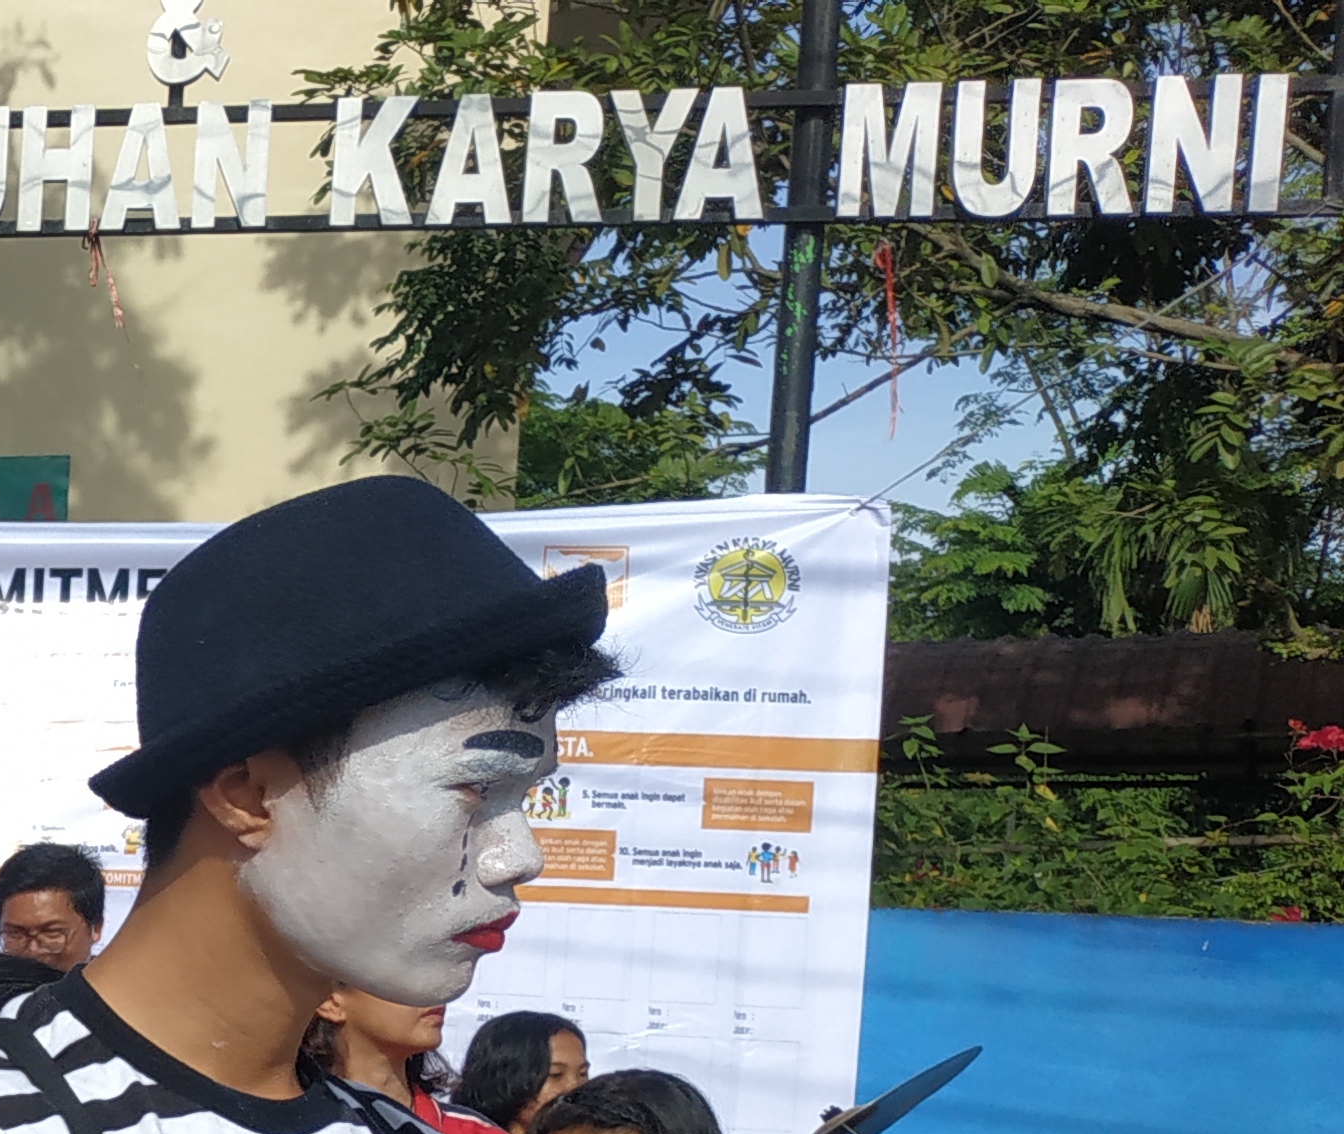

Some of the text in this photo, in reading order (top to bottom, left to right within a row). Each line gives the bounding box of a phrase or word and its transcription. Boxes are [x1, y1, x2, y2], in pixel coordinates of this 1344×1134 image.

[330, 86, 763, 227] KARYA
[836, 73, 1289, 219] MURNI
[693, 536, 801, 592] YAYASAN KARYA MURNI
[591, 685, 812, 705] eringkali terabaikan di rumah.
